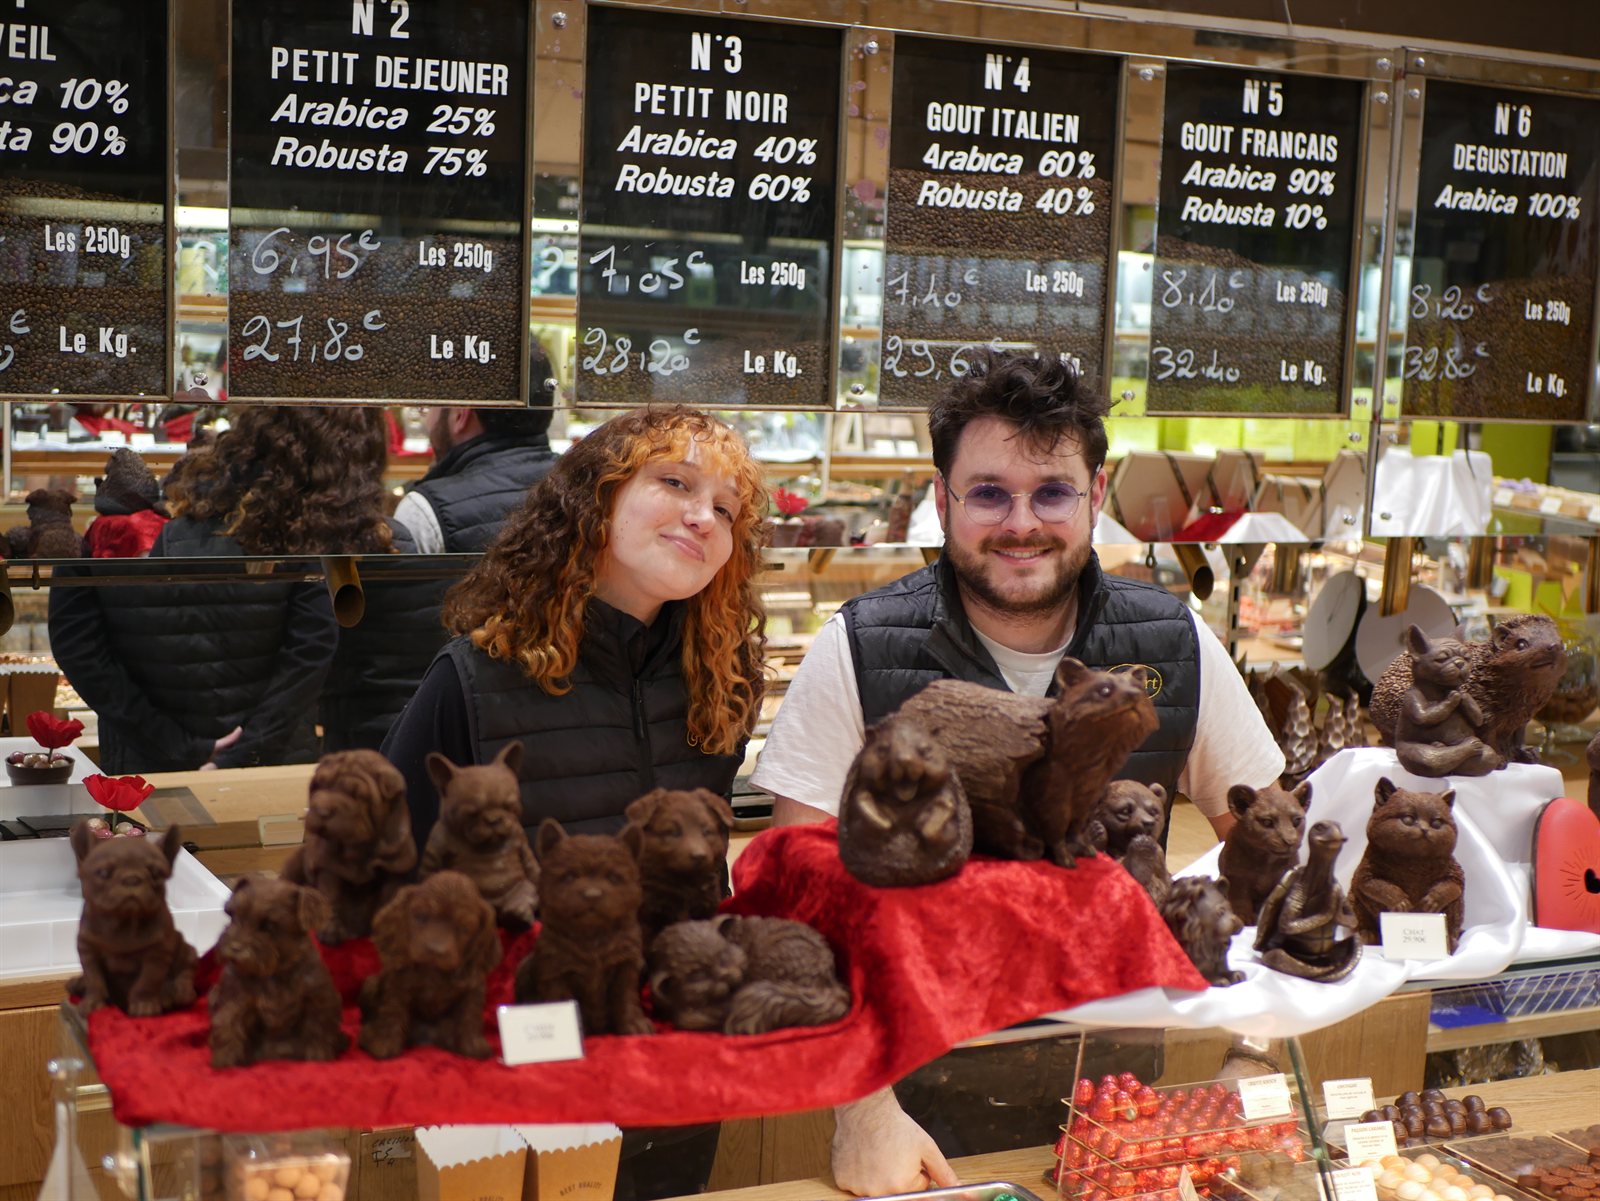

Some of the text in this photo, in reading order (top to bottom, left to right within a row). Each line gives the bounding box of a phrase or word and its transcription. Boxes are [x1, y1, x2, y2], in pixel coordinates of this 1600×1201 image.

[271, 46, 509, 96] PETIT DEJEUNER
[59, 78, 129, 114] 10%
[634, 82, 788, 124] PETIT NOIR
[270, 93, 497, 137] Arabica 25%
[926, 101, 1080, 144] GOUT ITALIEN
[49, 121, 126, 156] 90%
[270, 136, 488, 177] Robusta 75%
[616, 125, 818, 165] Arabica 40%
[1180, 122, 1338, 163] GOUT FRANCAIS
[922, 143, 1096, 180] Arabica 60%
[1181, 160, 1336, 196] Arabica 90%
[1453, 143, 1567, 179] DEGUSTATION
[614, 164, 812, 203] Robusta 60%
[916, 179, 1095, 216] Robusta 40%
[1180, 196, 1328, 230] Robusta 10%
[1434, 184, 1582, 220] Arabica 100%
[45, 224, 131, 259] Les 250g
[419, 240, 447, 267] Les
[453, 242, 493, 273] 250g
[740, 260, 765, 285] Les
[770, 261, 806, 291] 250g
[1025, 269, 1048, 293] Les
[1052, 270, 1084, 298] 250g
[1276, 280, 1297, 303] Les
[1300, 281, 1328, 308] 250g
[1525, 299, 1543, 321] Les
[1545, 300, 1571, 326] 250g
[59, 325, 87, 354] Le
[99, 327, 137, 358] Kg.
[430, 334, 454, 360] Le
[464, 334, 497, 364] Kg.
[743, 350, 765, 374] Le
[773, 350, 803, 378] Kg.
[1280, 359, 1298, 382] Le
[1303, 360, 1327, 386] Kg.
[1526, 372, 1542, 393] Le
[1547, 373, 1568, 398] Kg.
